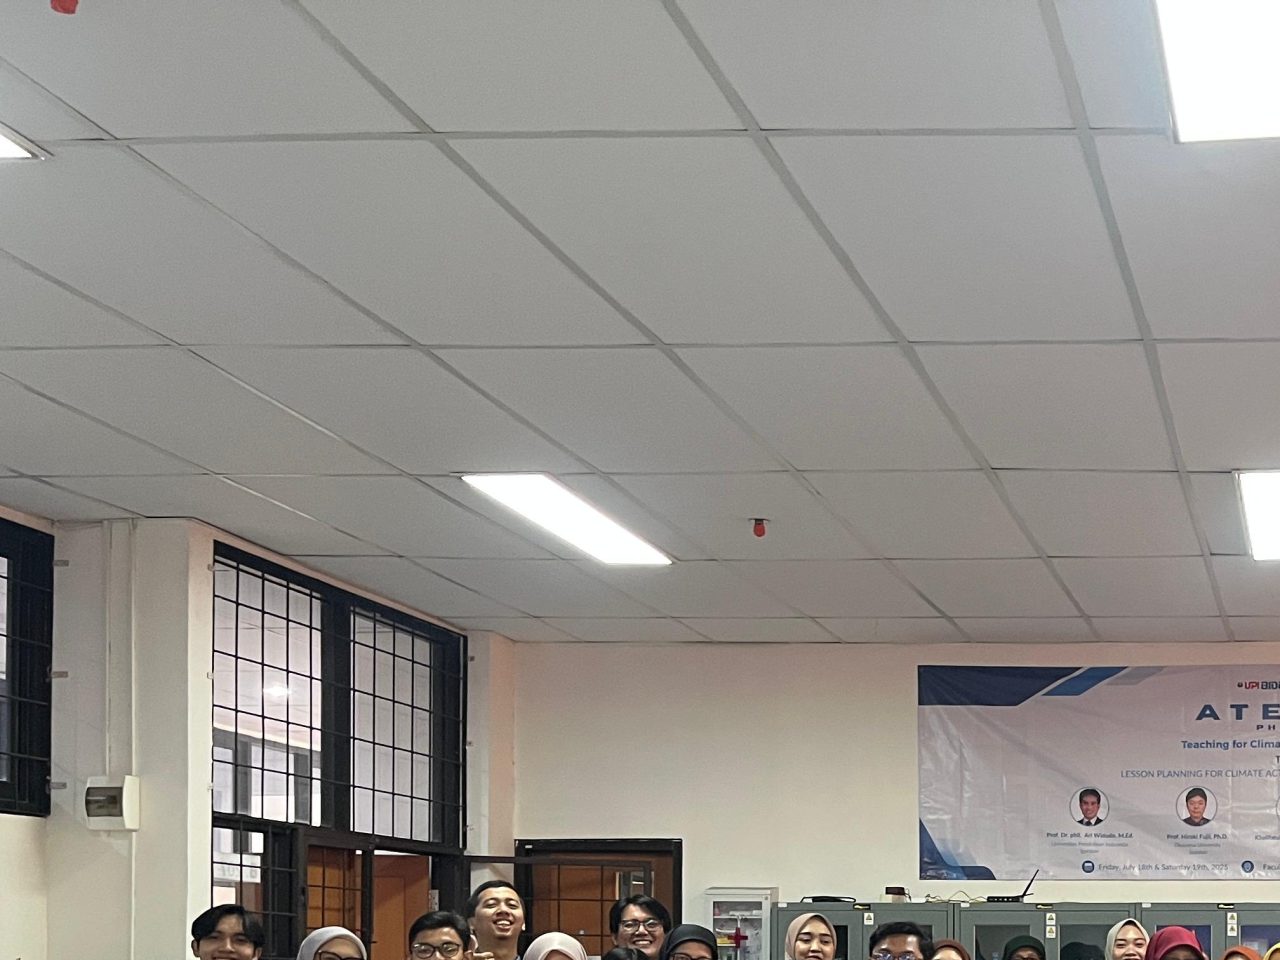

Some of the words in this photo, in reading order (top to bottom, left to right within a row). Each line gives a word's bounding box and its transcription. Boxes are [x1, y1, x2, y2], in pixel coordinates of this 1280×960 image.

[1181, 740, 1229, 751] Teaching
[1232, 740, 1247, 749] for
[1121, 770, 1155, 778] LESSON
[1156, 769, 1203, 778] PLANNING
[1205, 769, 1223, 778] FOR
[1225, 769, 1262, 778] CLIMATE
[1123, 863, 1136, 871] July
